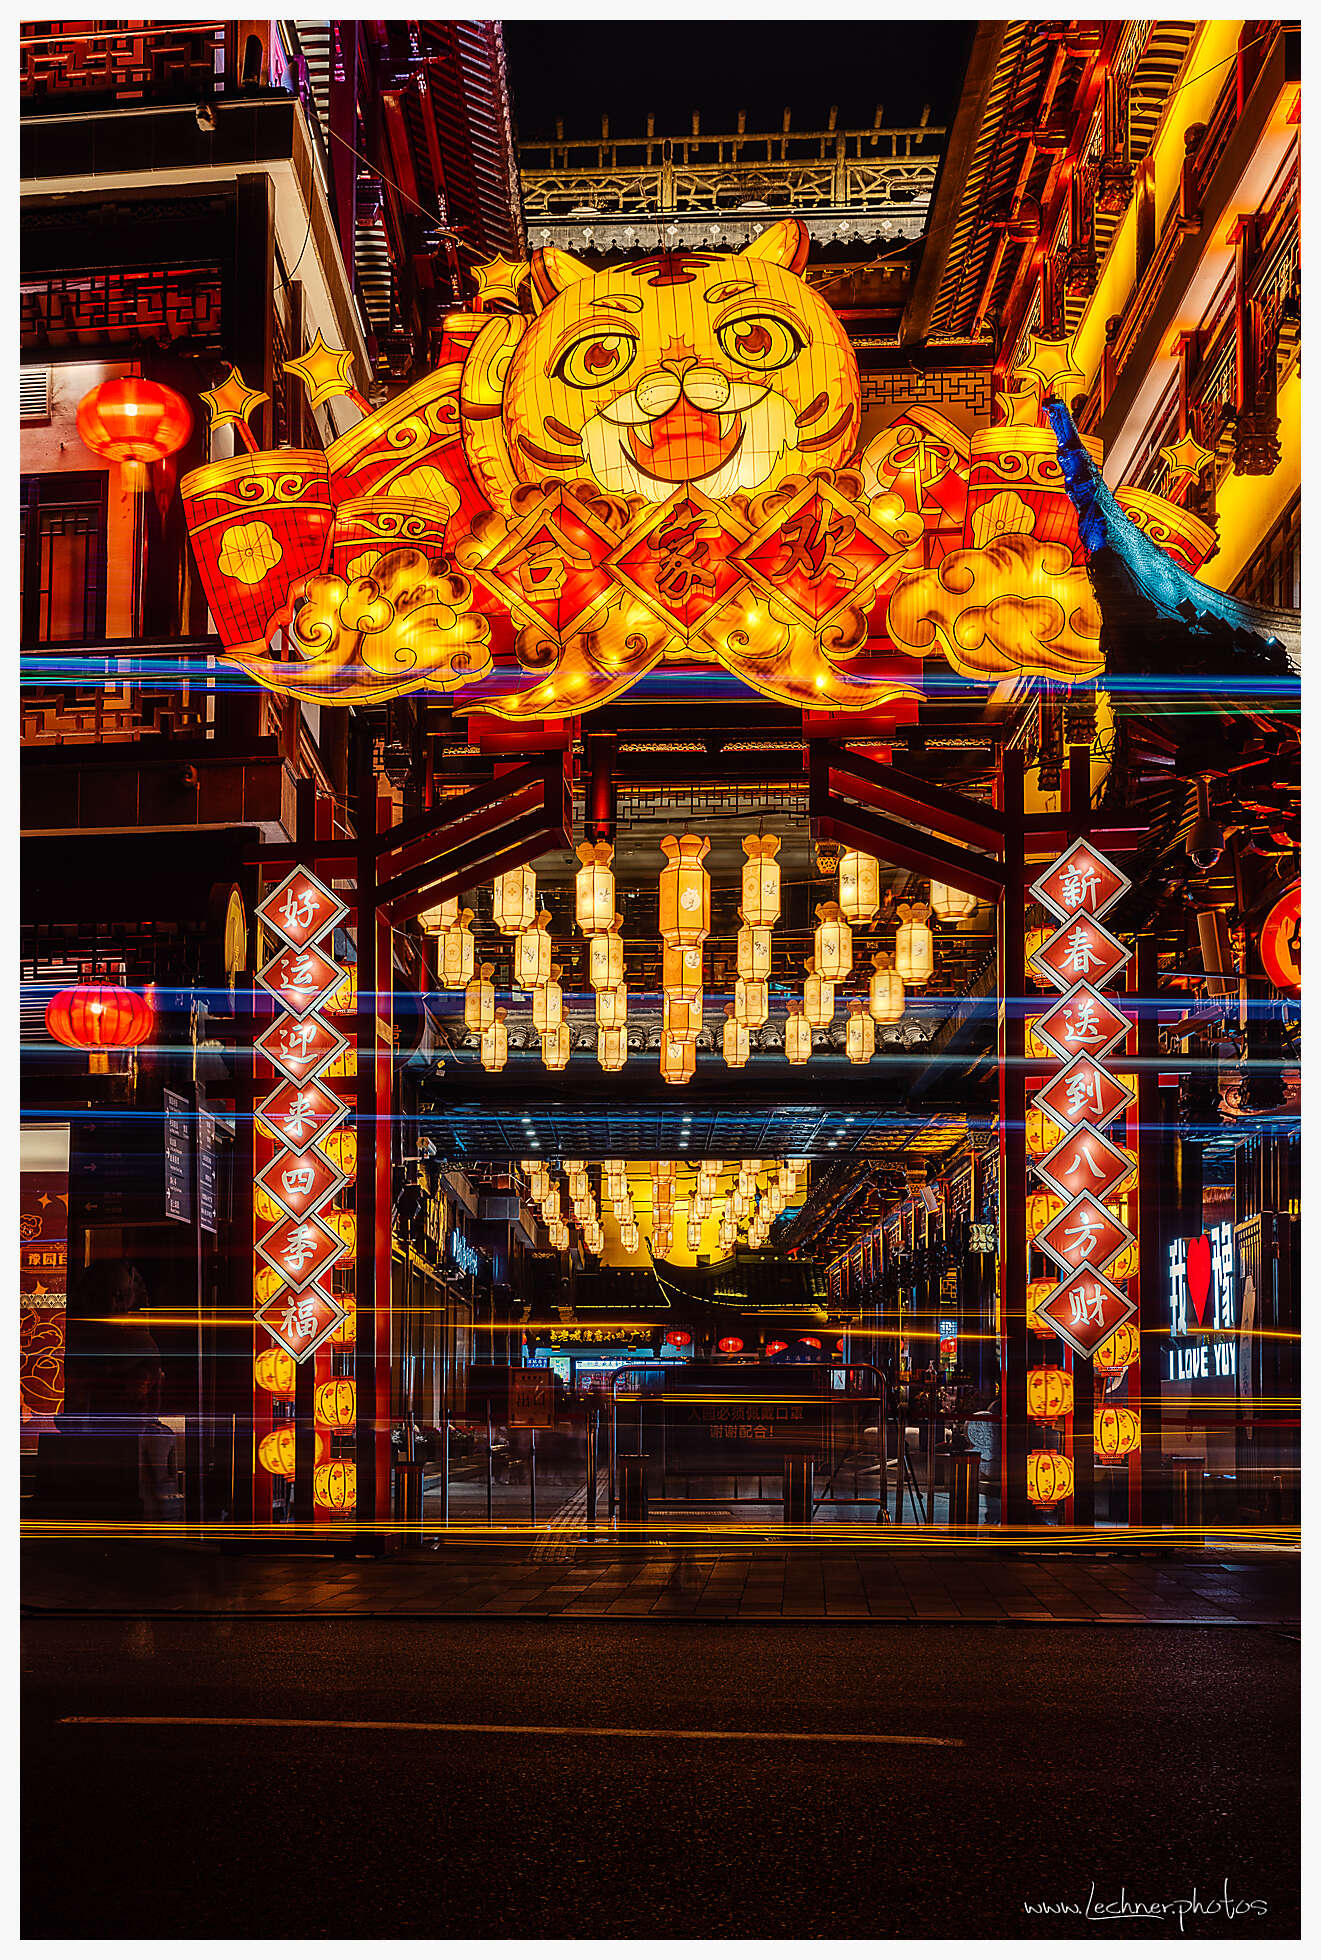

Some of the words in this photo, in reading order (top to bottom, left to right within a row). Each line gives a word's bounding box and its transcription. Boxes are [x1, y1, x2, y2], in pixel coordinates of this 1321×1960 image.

[278, 886, 320, 1341] 好运迎来四季福
[1058, 862, 1109, 1330] 新春送到八方财
[1169, 1349, 1174, 1380] I
[1178, 1345, 1208, 1380] LOVE
[1213, 1341, 1236, 1376] YUY
